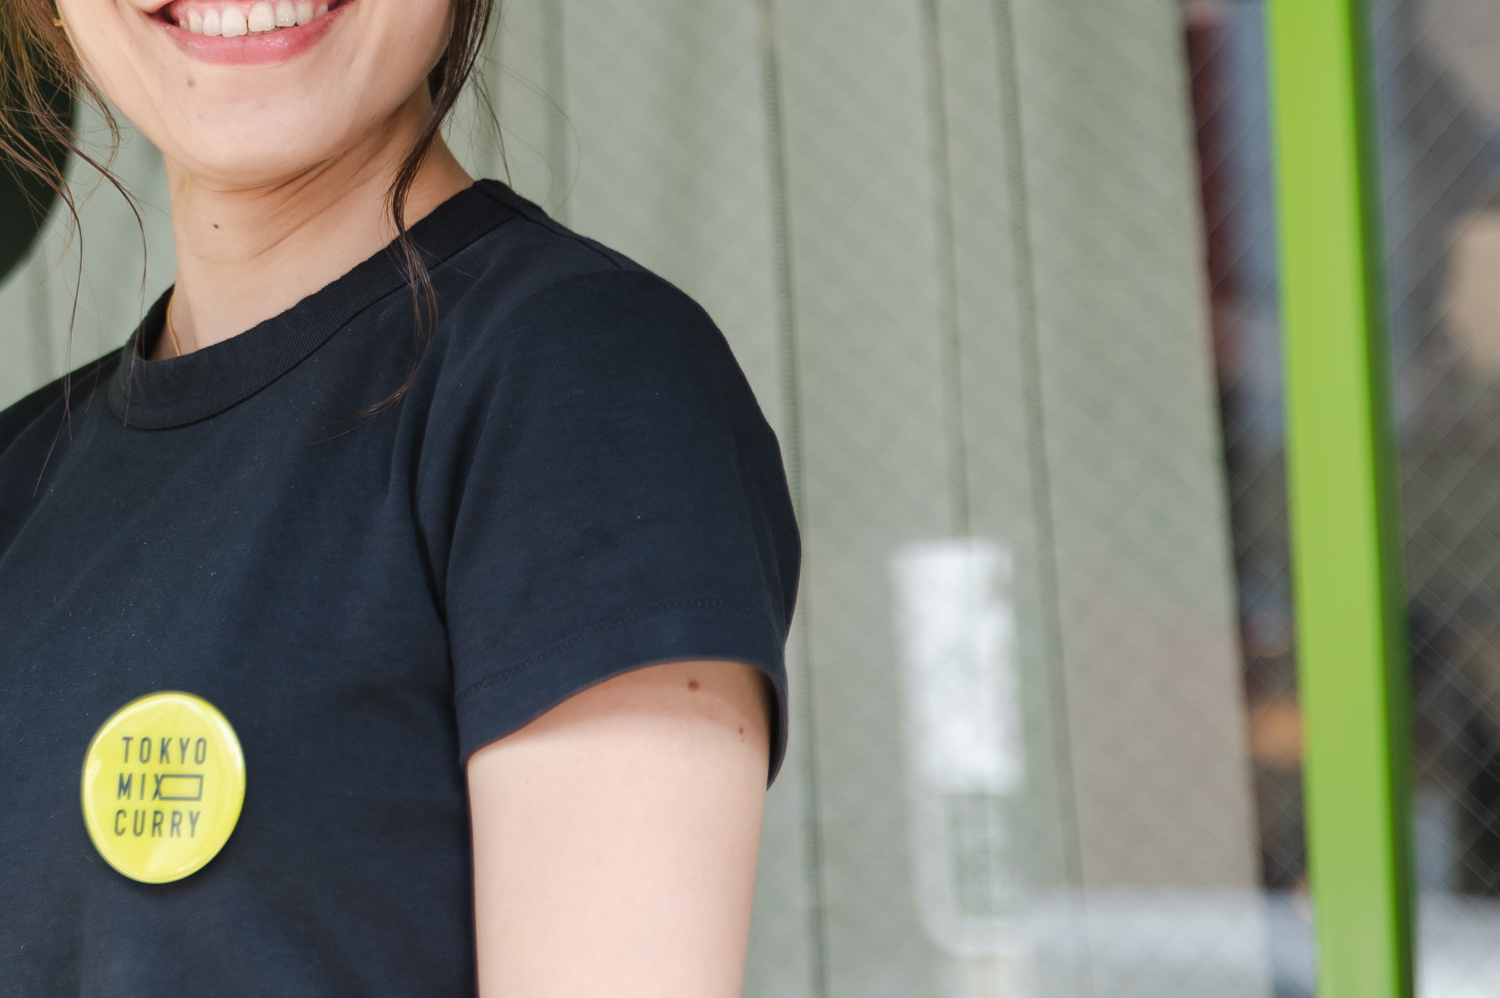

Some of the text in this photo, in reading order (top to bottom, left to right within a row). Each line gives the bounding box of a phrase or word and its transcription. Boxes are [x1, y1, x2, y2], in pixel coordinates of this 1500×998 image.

[121, 736, 208, 765] TOKYO
[116, 773, 165, 801] MIX
[114, 809, 201, 838] CURRY
